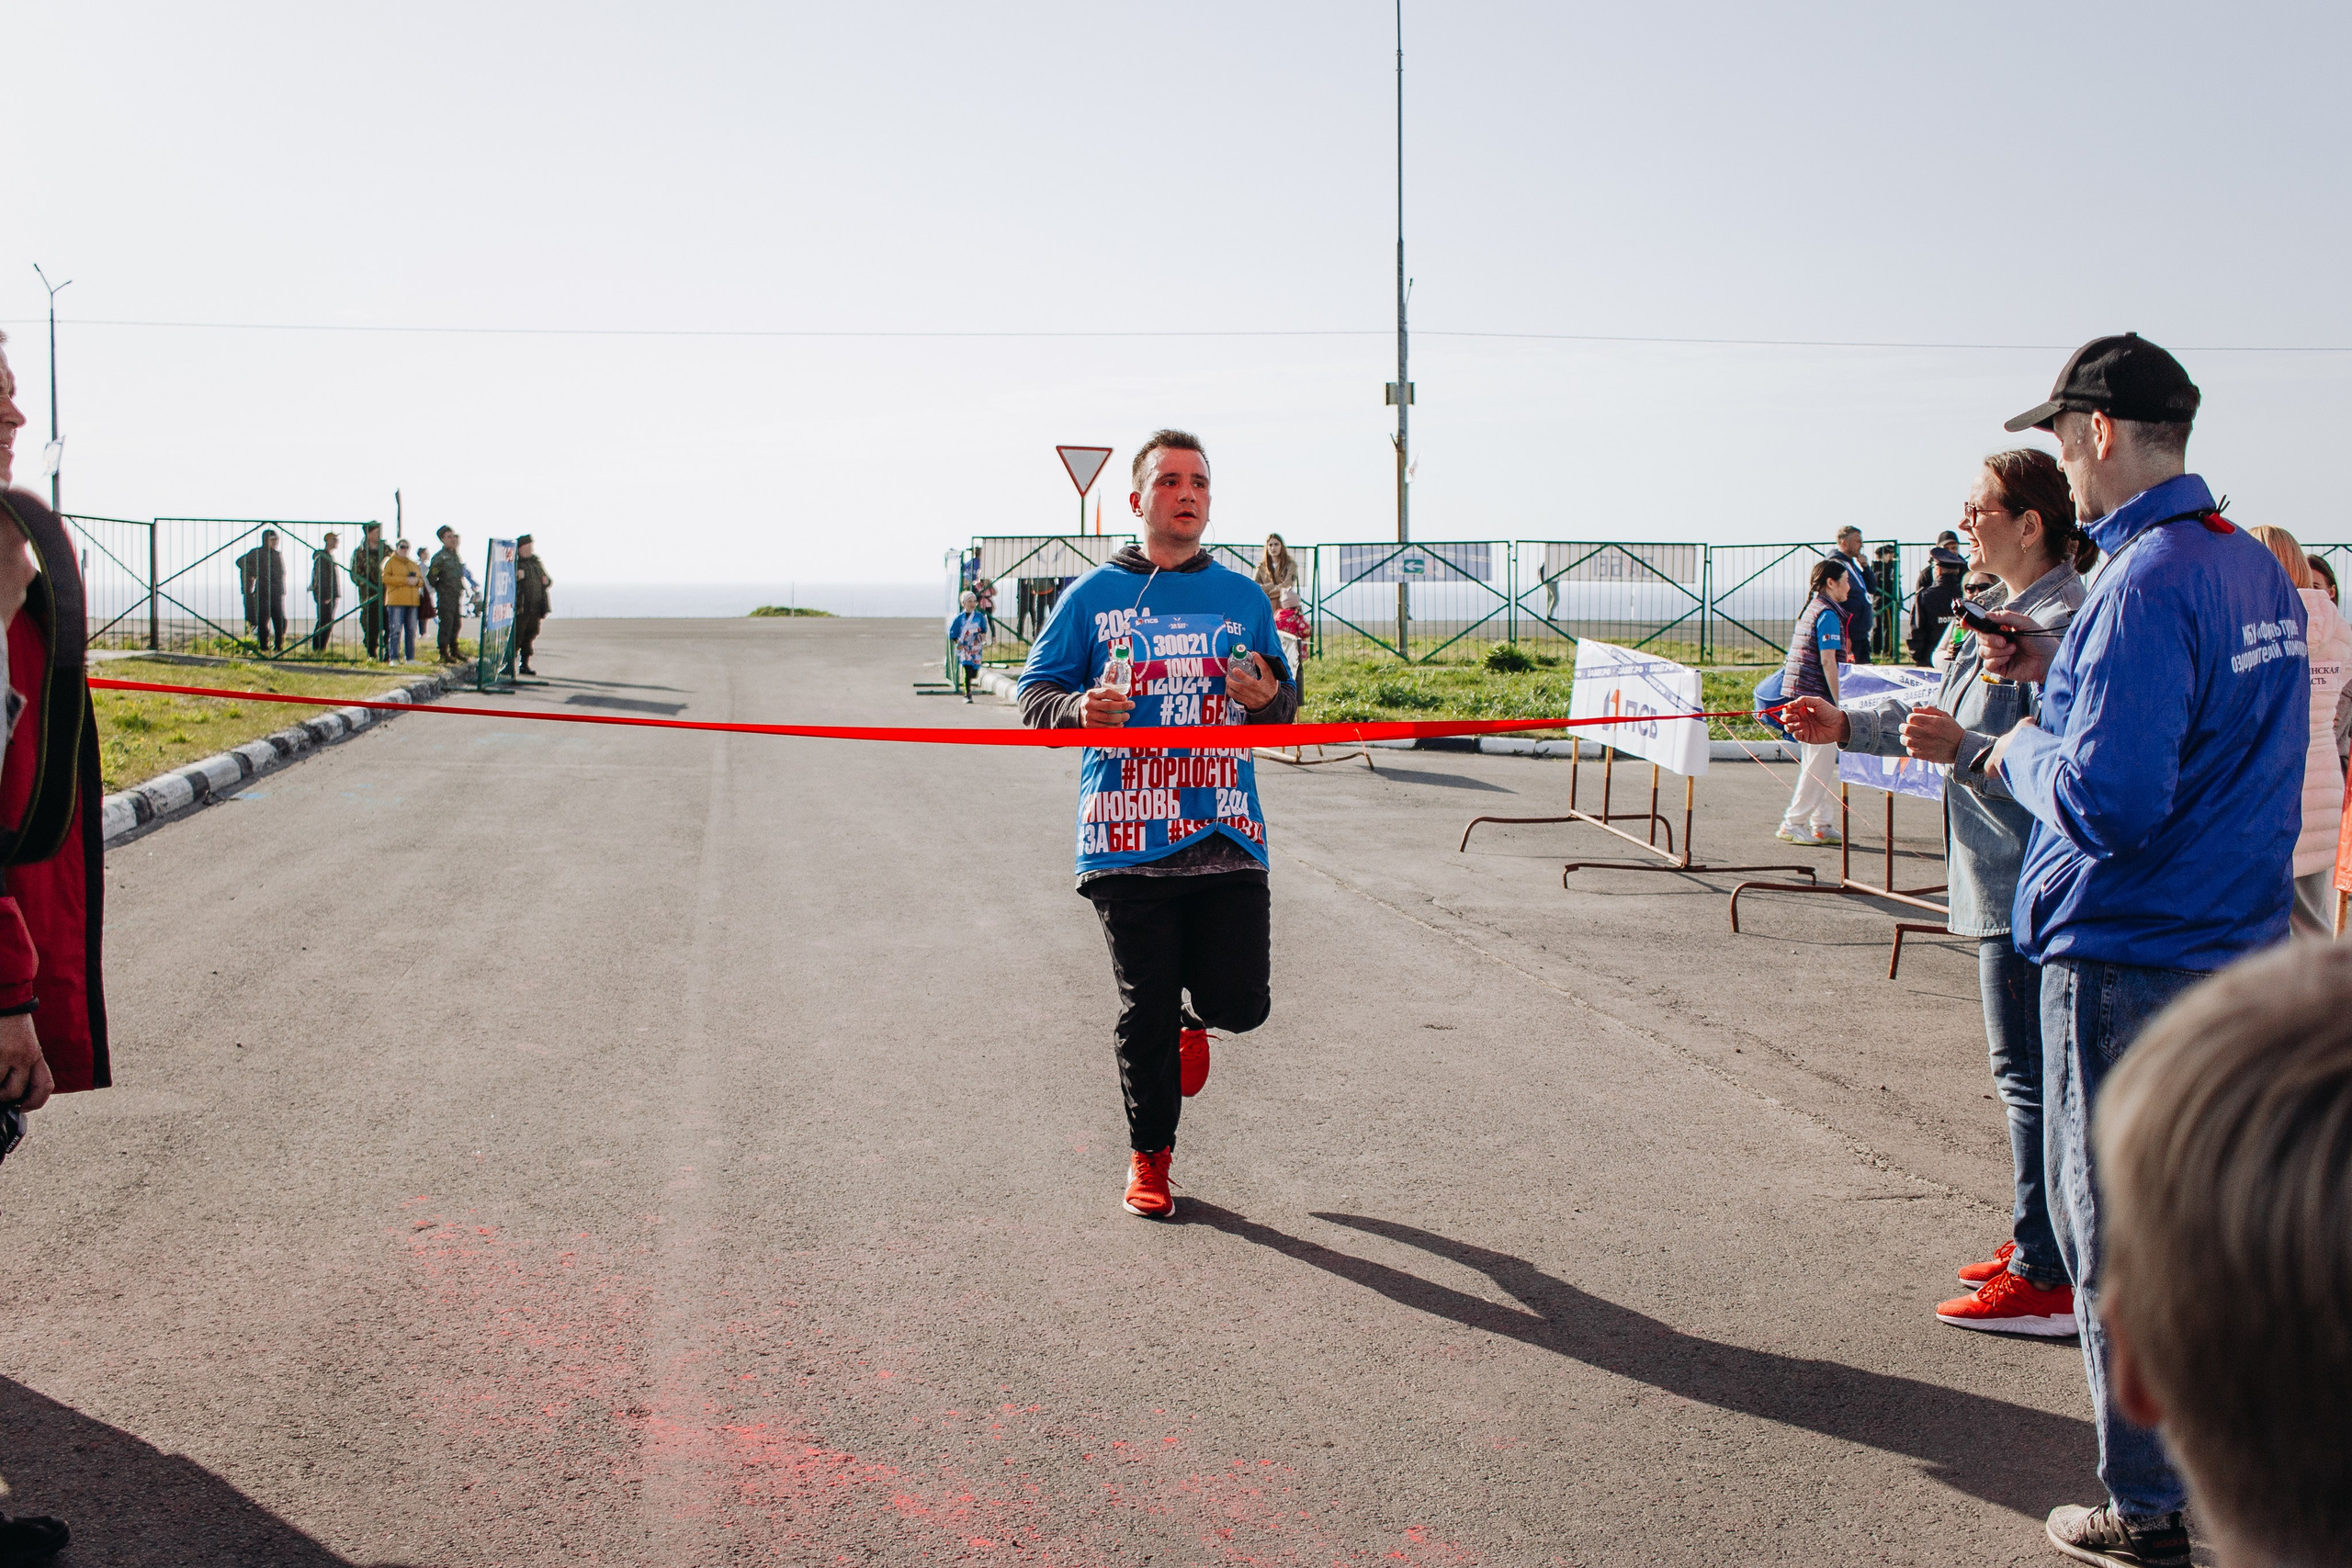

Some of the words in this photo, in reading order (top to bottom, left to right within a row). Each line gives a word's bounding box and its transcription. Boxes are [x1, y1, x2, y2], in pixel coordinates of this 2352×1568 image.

[1153, 633, 1209, 656] 30021
[1121, 756, 1239, 791] #ГОРДОСТЬ
[1078, 820, 1147, 856] #ЗАБЕГ
